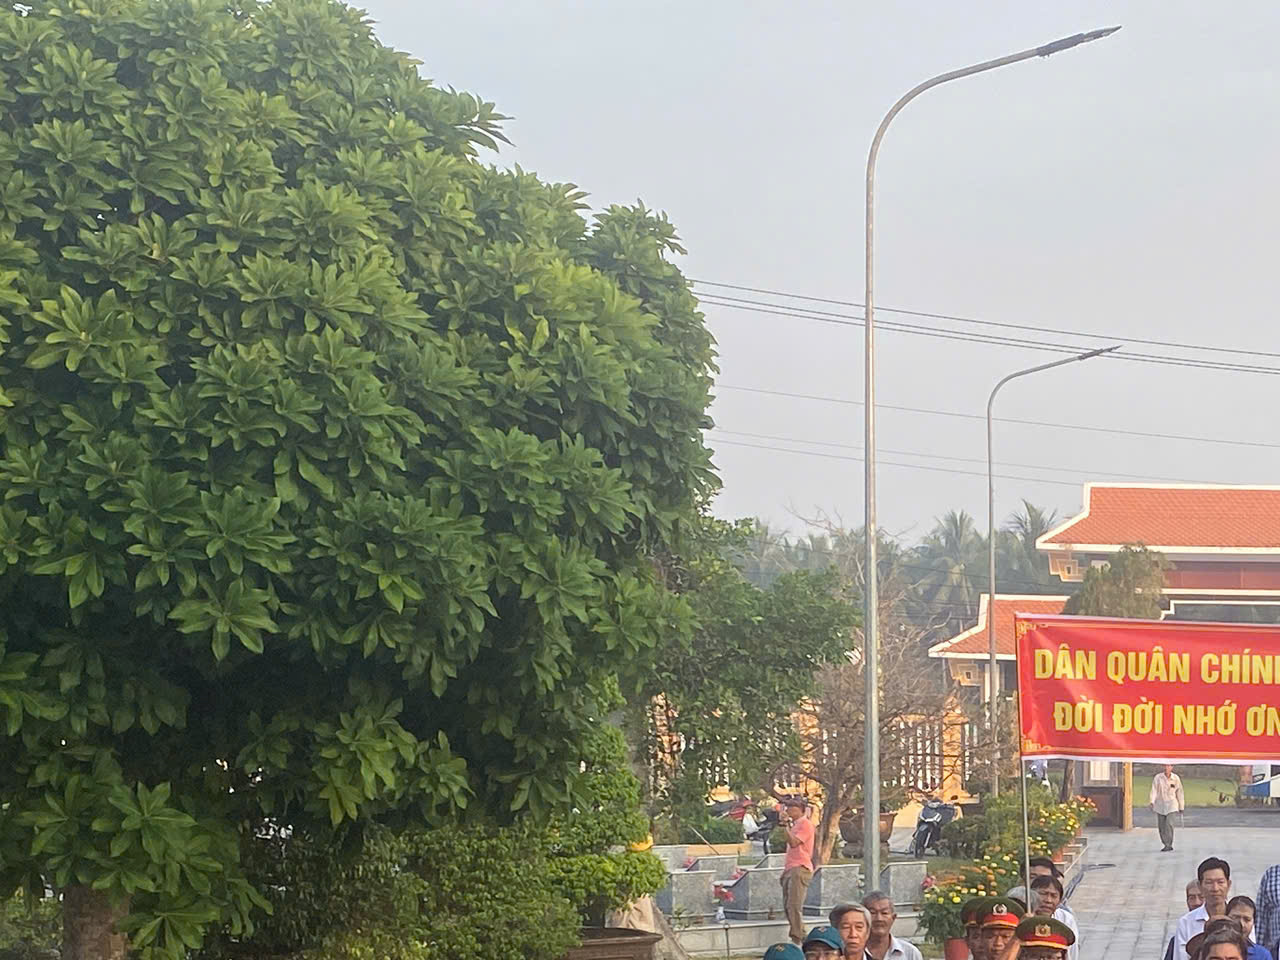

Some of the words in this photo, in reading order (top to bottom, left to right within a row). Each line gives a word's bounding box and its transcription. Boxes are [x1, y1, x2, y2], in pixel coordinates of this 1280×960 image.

[1034, 643, 1097, 682] DÂN
[1106, 645, 1191, 685] QUÂN
[1053, 694, 1104, 733] ĐỜI
[1112, 696, 1163, 735] ĐỜI
[1173, 699, 1238, 736] NHỚ
